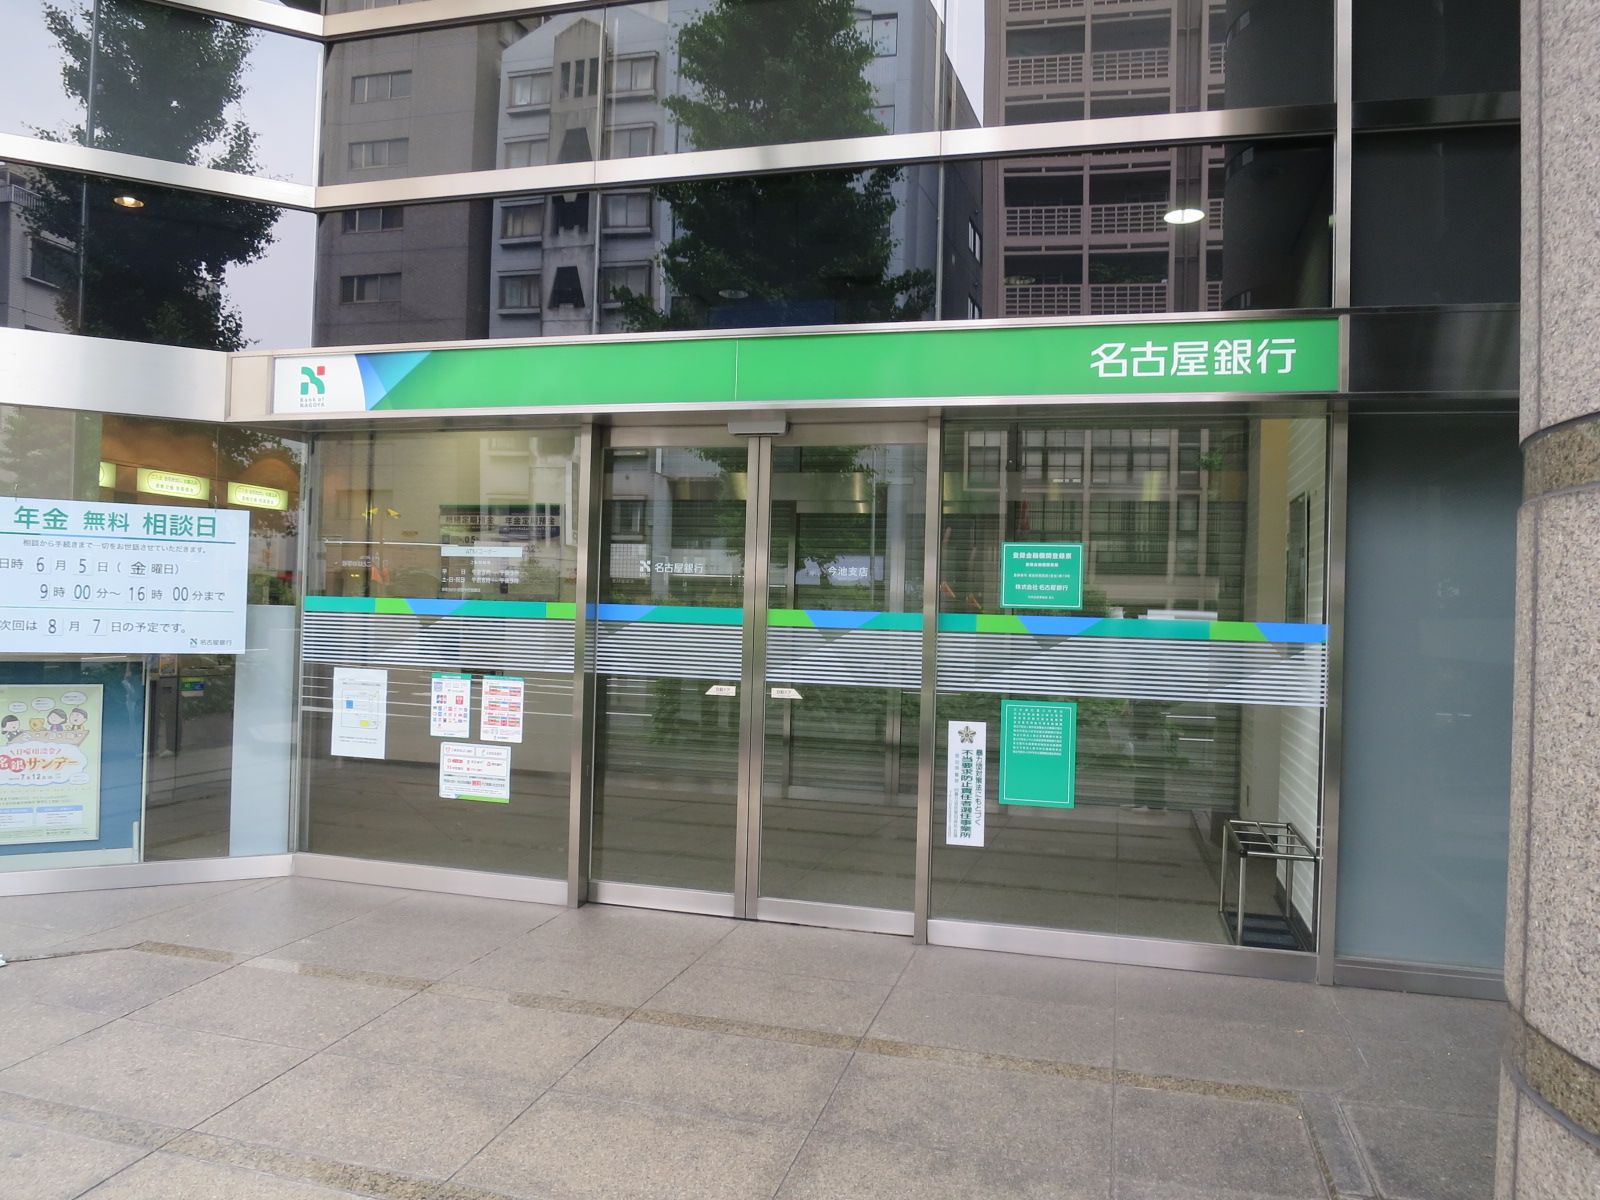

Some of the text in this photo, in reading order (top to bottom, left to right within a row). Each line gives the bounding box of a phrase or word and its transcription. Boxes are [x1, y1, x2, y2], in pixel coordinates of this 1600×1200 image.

[1090, 338, 1297, 378] 名古屋銀行
[14, 505, 217, 538] 年金 無料 相談日
[36, 557, 46, 573] 6
[55, 559, 67, 571] 月
[78, 558, 88, 574] 5
[130, 561, 147, 576] 金
[654, 562, 704, 574] 名古屋銀行
[827, 566, 869, 577] 今池支店
[39, 583, 49, 600] 9
[53, 586, 65, 598] 時
[73, 583, 91, 600] 00
[128, 586, 146, 602] 16
[151, 589, 163, 601] 時
[172, 586, 190, 602] 00
[191, 590, 226, 602] 分まで
[0, 618, 188, 635] 次回は 8 月 7 日の予定です。
